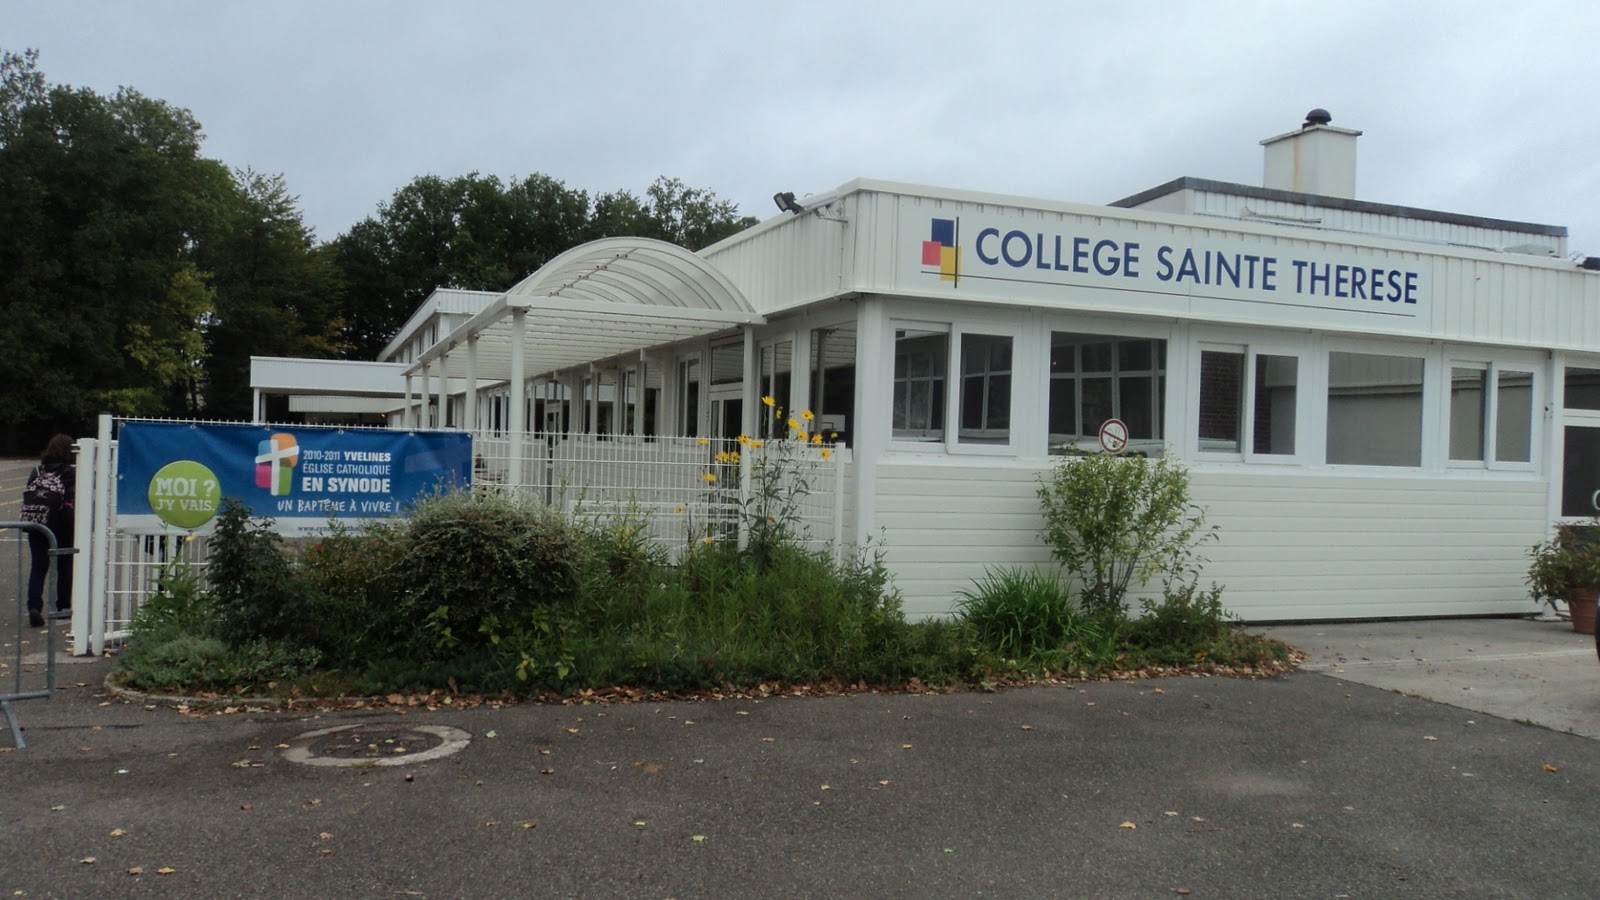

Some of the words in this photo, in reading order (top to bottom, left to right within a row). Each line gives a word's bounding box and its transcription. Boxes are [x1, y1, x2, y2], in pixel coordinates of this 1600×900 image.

[976, 227, 1140, 278] COLLEGE
[1156, 245, 1277, 291] SAINTE
[1292, 260, 1418, 304] THERESE
[303, 450, 340, 460] 2010-2011
[344, 451, 391, 462] YVELINES
[303, 461, 334, 474] ÉGLISE
[336, 464, 391, 476] CATHOLIQUE
[155, 477, 197, 497] MOI
[203, 479, 216, 497] ?
[302, 477, 323, 492] EN
[327, 477, 391, 493] SYNODE
[155, 499, 175, 511] J'Y
[277, 500, 293, 512] UN
[350, 499, 357, 512] À
[361, 501, 392, 513] VIVRE
